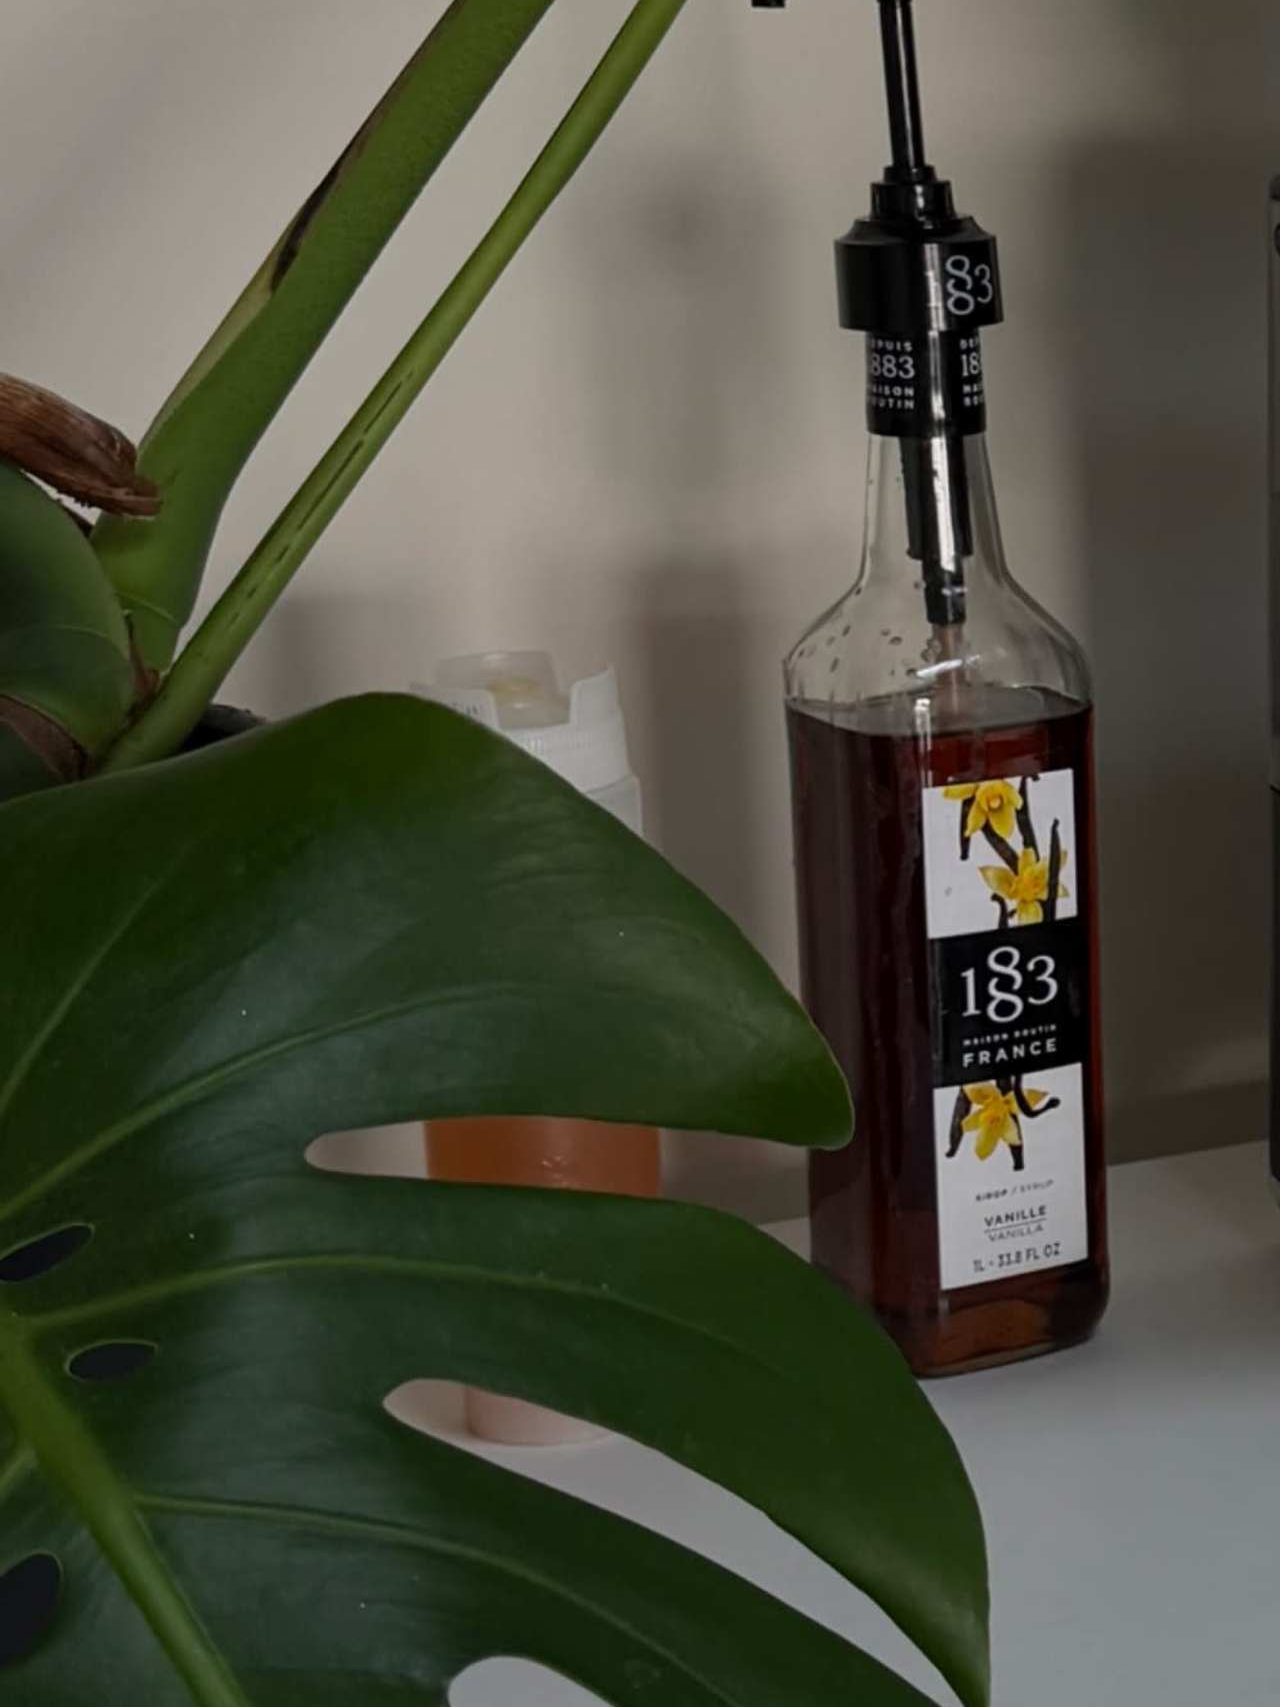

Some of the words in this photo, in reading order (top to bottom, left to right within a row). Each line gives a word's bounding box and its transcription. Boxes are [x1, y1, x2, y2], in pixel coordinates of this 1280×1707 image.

[869, 353, 916, 380] 883
[959, 945, 1059, 1024] 1883
[962, 1037, 1058, 1069] FRANCE
[984, 1205, 1047, 1226] VANILLE
[988, 1224, 1045, 1242] VANILLA
[1025, 1248, 1039, 1262] FL
[1043, 1242, 1061, 1259] OZ
